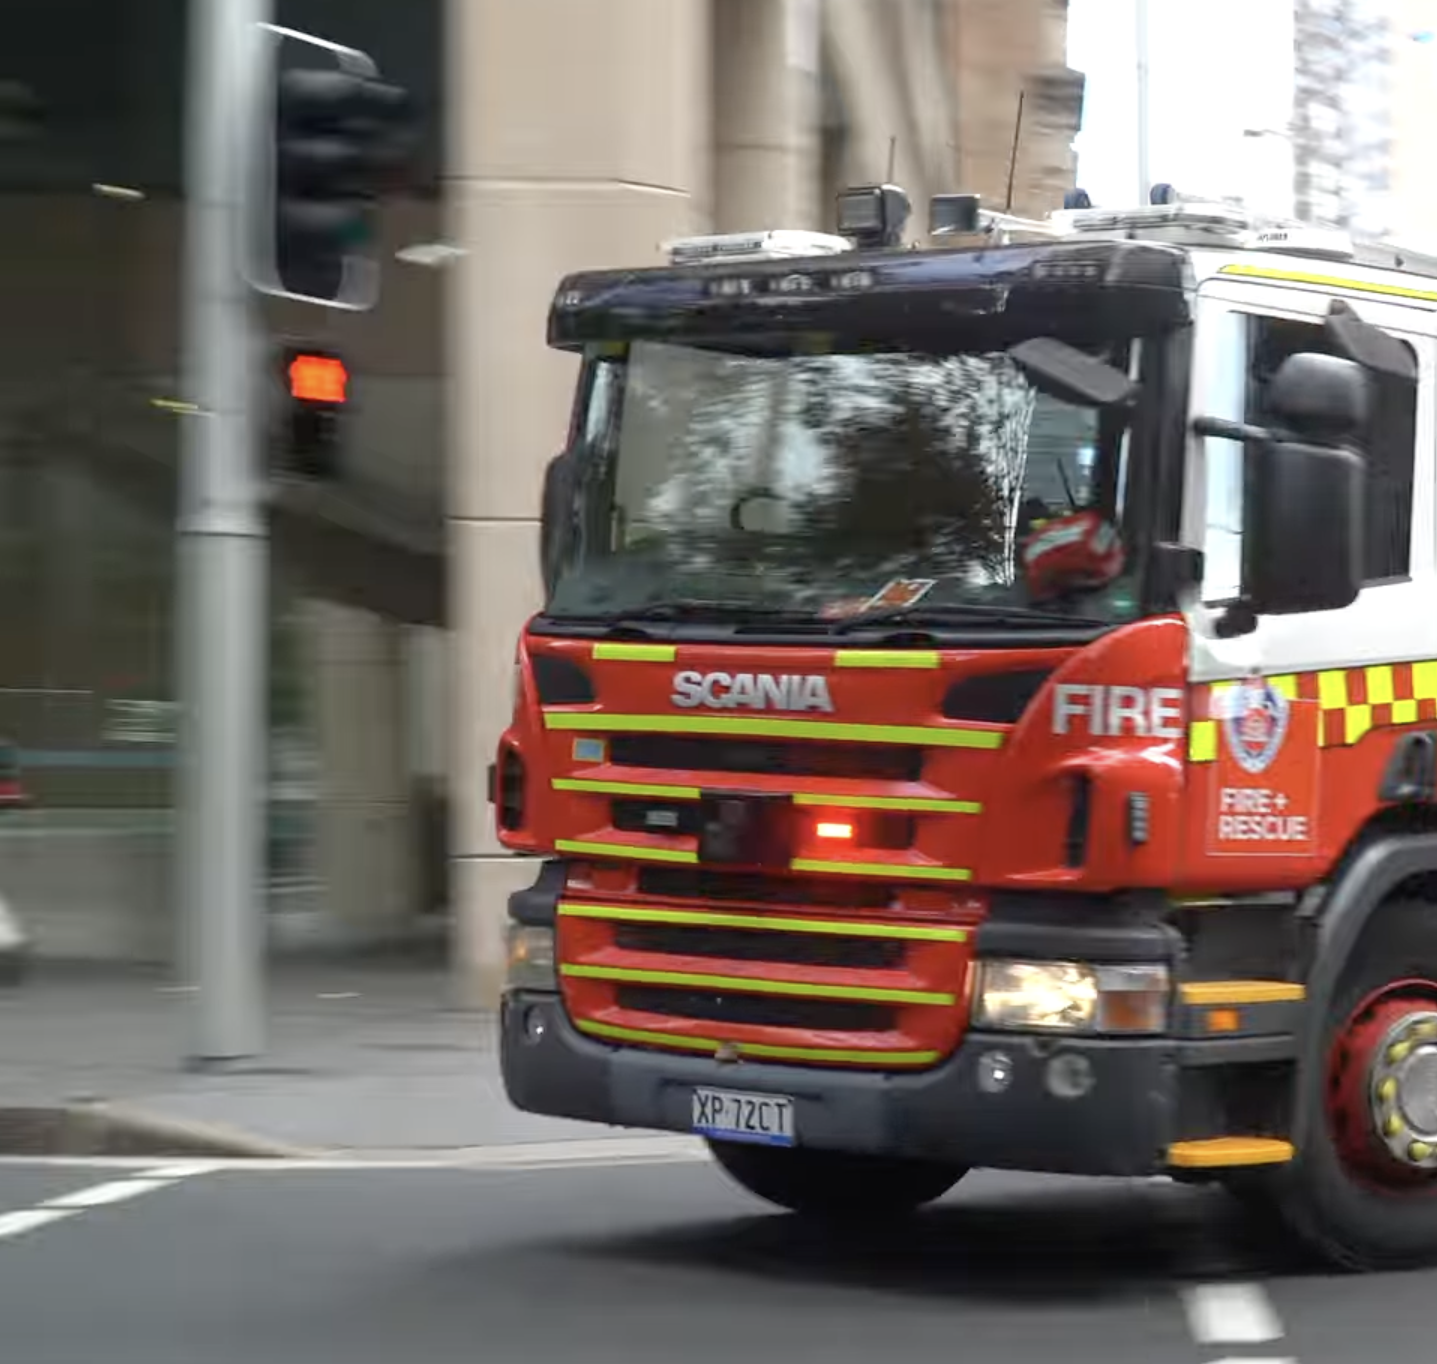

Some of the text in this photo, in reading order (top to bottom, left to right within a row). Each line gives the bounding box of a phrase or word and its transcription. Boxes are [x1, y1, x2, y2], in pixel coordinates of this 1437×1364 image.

[670, 670, 834, 712] SCANIA
[1052, 683, 1184, 738] FIRE
[1219, 814, 1309, 841] RESCUE
